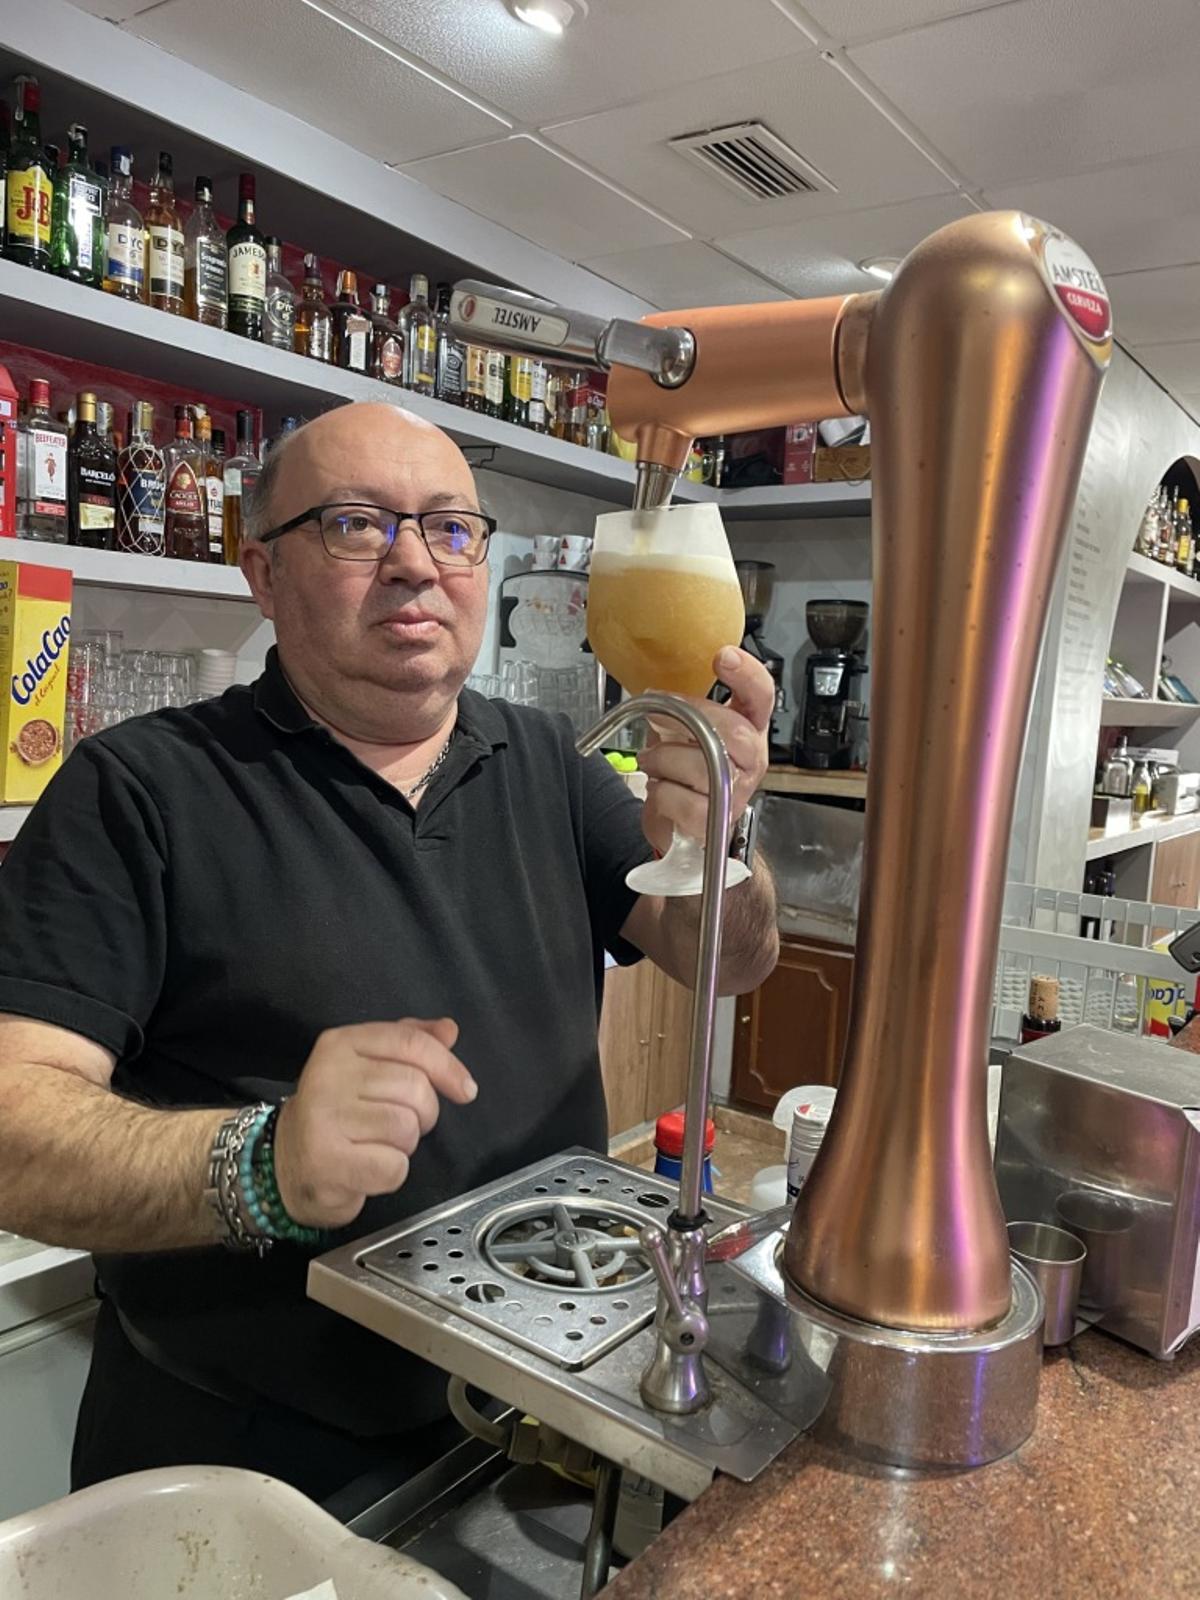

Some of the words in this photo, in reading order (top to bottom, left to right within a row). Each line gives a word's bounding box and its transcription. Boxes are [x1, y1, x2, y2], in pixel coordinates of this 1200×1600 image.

[1052, 263, 1105, 295] AMSTEL
[493, 307, 541, 334] AMSTEL
[35, 433, 66, 448] BEEFEATER
[12, 615, 71, 705] ColaCao
